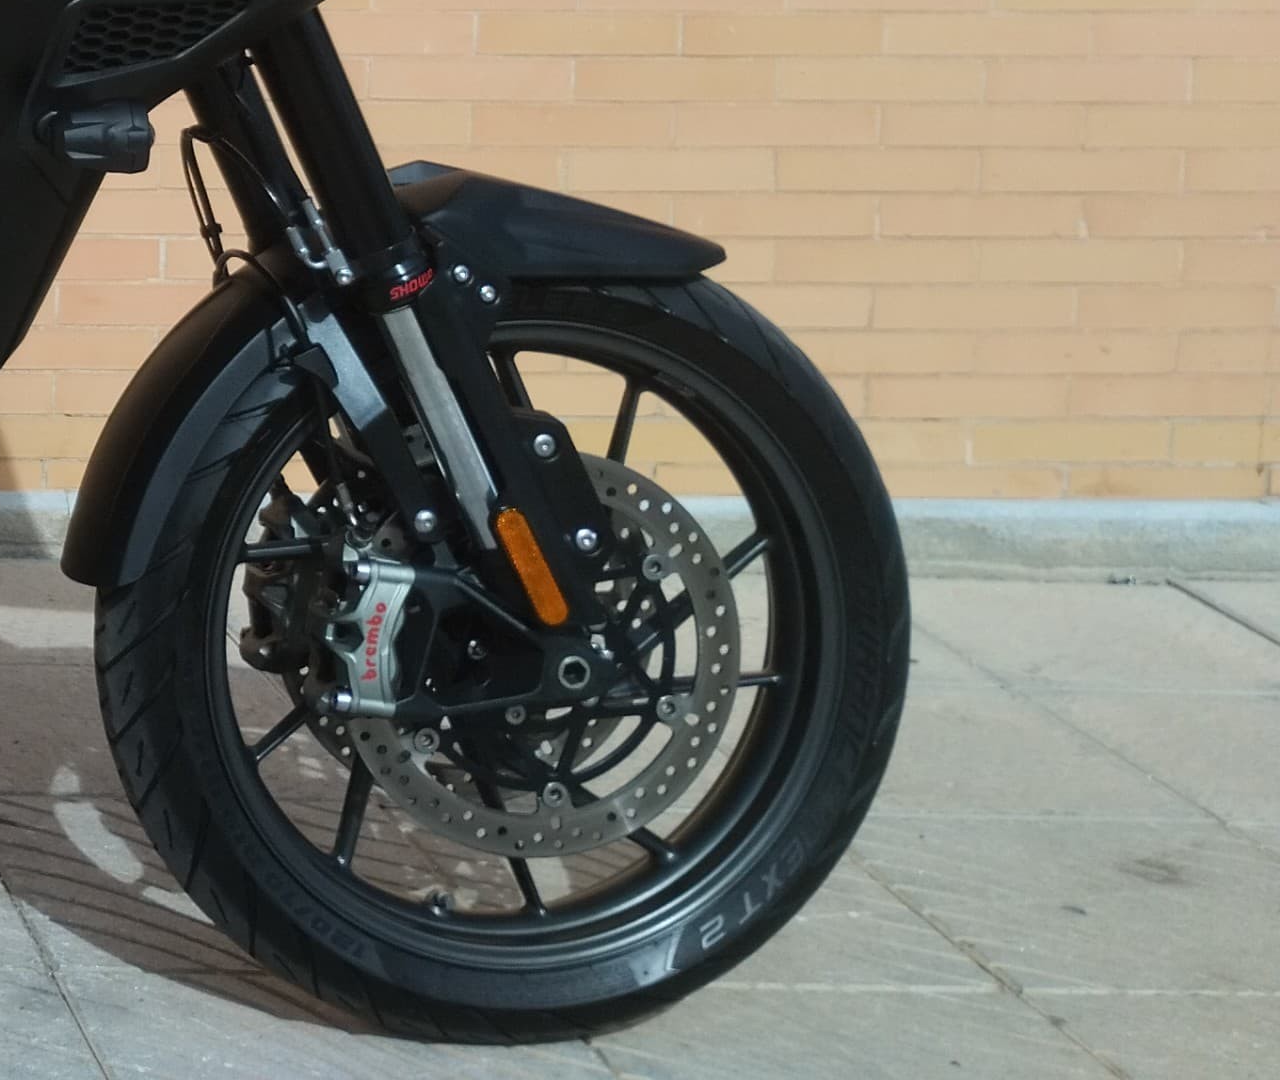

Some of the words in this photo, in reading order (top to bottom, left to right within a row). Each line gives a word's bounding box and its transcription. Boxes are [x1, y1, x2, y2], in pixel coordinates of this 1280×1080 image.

[360, 601, 387, 682] brembo
[738, 836, 806, 926] EXT
[699, 913, 727, 950] 2
